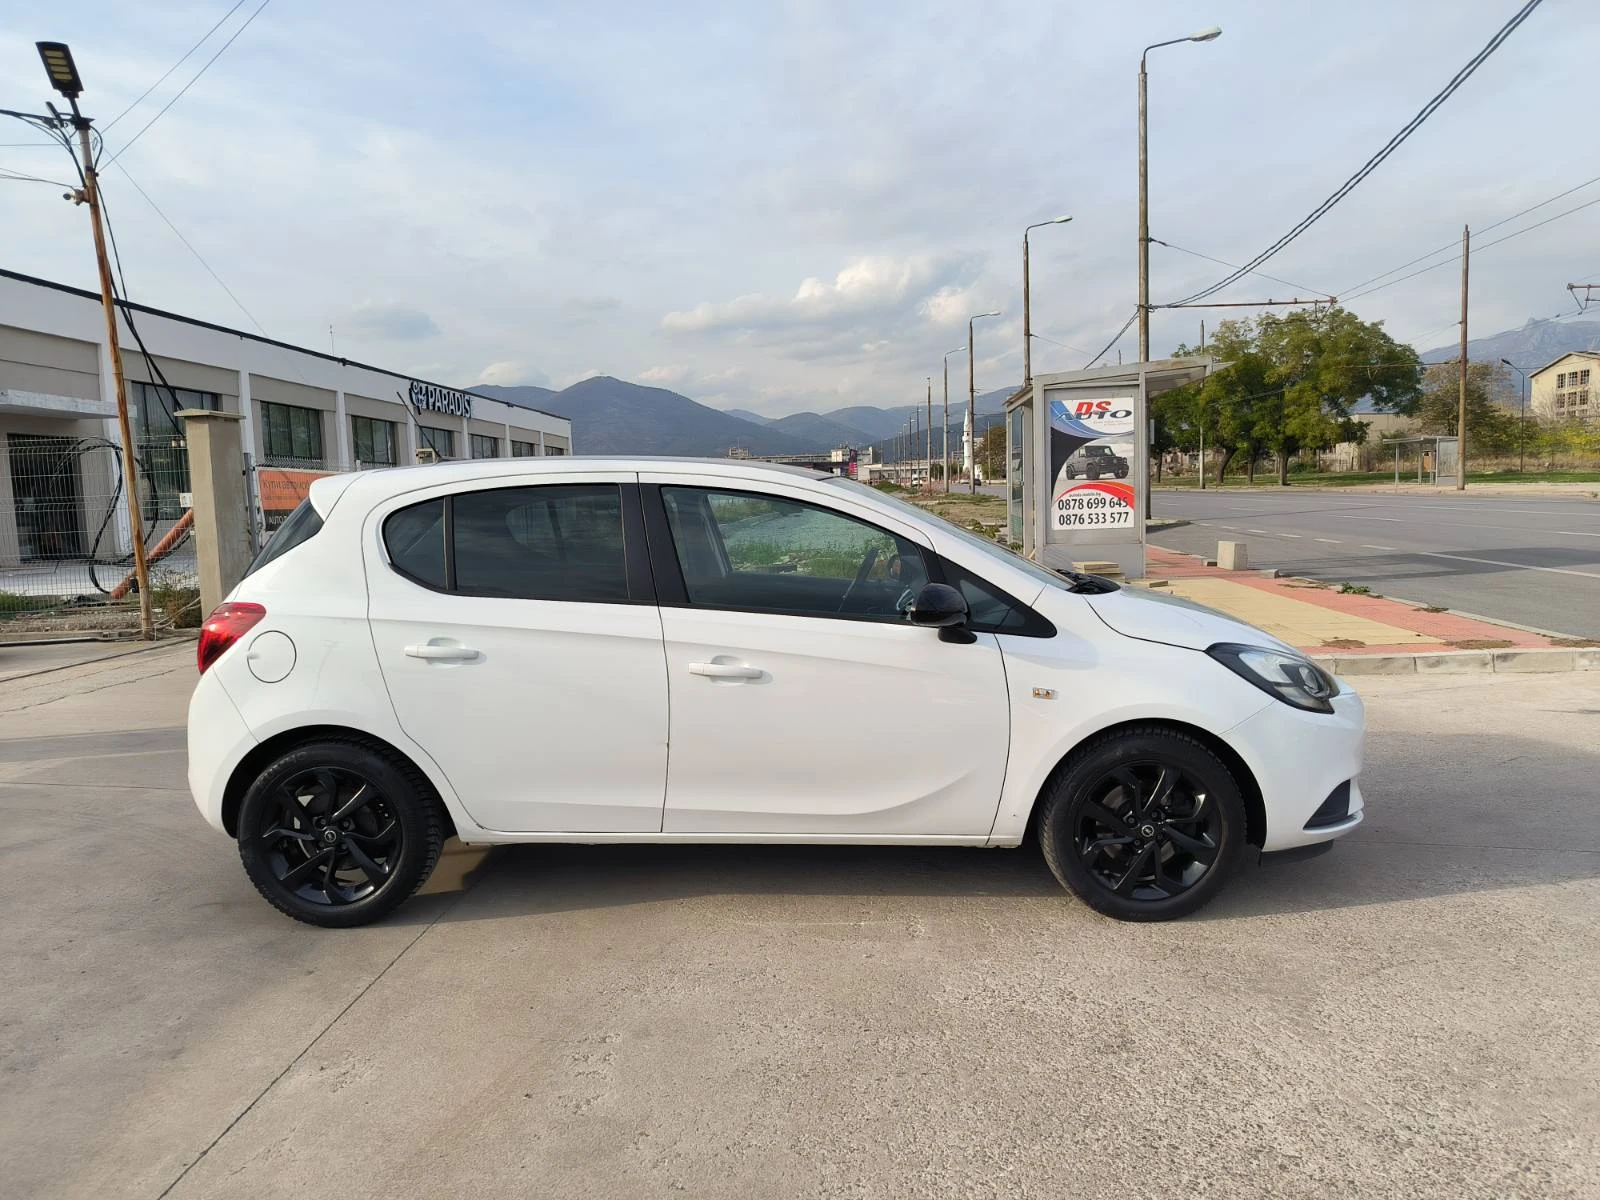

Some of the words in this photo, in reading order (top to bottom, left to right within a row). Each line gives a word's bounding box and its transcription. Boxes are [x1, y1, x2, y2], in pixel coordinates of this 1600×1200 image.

[428, 387, 471, 418] PARADIS
[1075, 401, 1112, 415] DS
[1058, 498, 1084, 511] 0878
[1086, 497, 1106, 509] 699
[1109, 496, 1129, 508] 645
[1058, 513, 1085, 526] 0876
[1088, 512, 1107, 524] 533
[1110, 511, 1129, 523] 577
